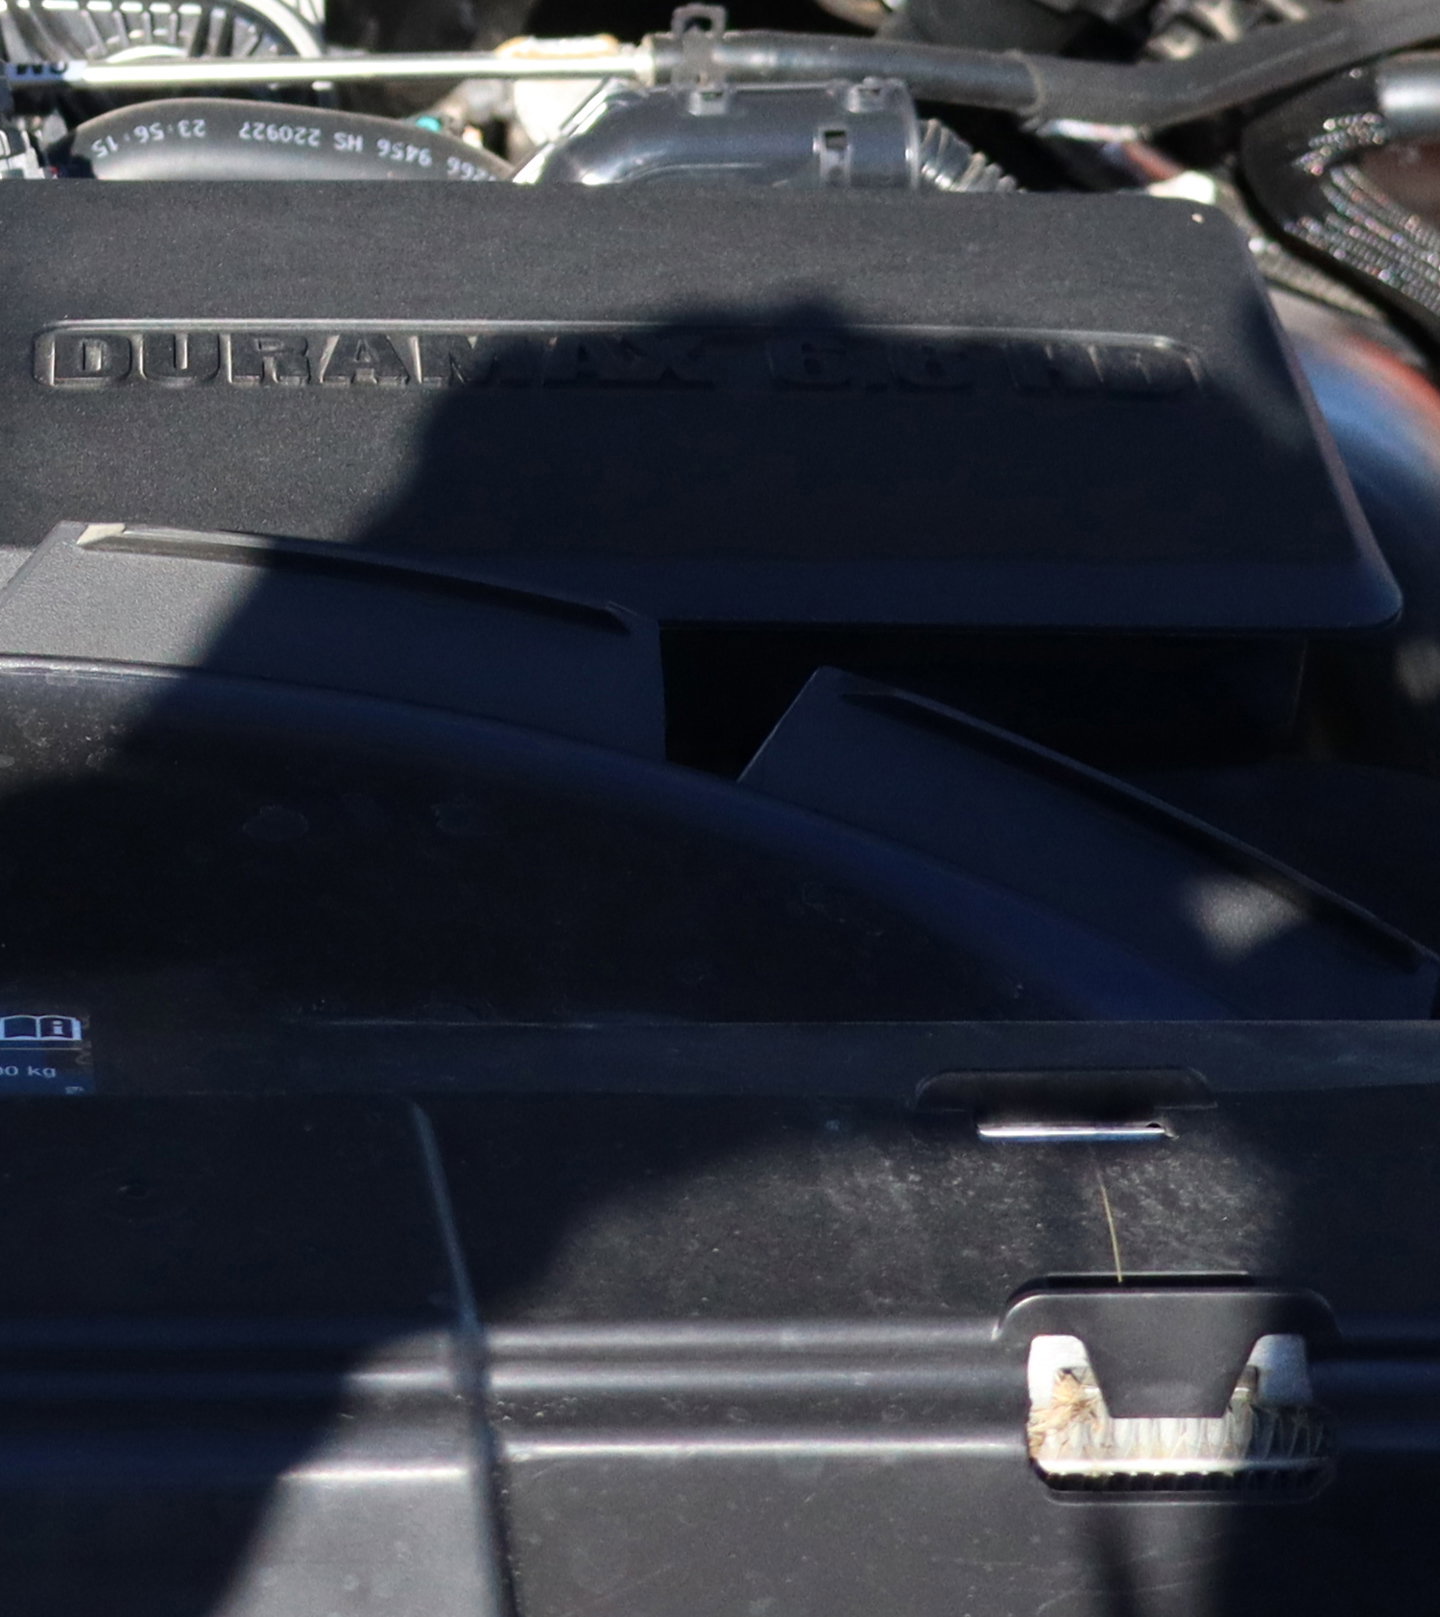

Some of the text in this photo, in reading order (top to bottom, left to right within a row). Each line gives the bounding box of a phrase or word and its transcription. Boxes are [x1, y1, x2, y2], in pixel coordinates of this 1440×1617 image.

[238, 120, 322, 148] 220927
[333, 131, 364, 153] HS
[377, 138, 433, 168] 9456
[50, 332, 712, 387] DURAMAX
[27, 1064, 57, 1079] kg
